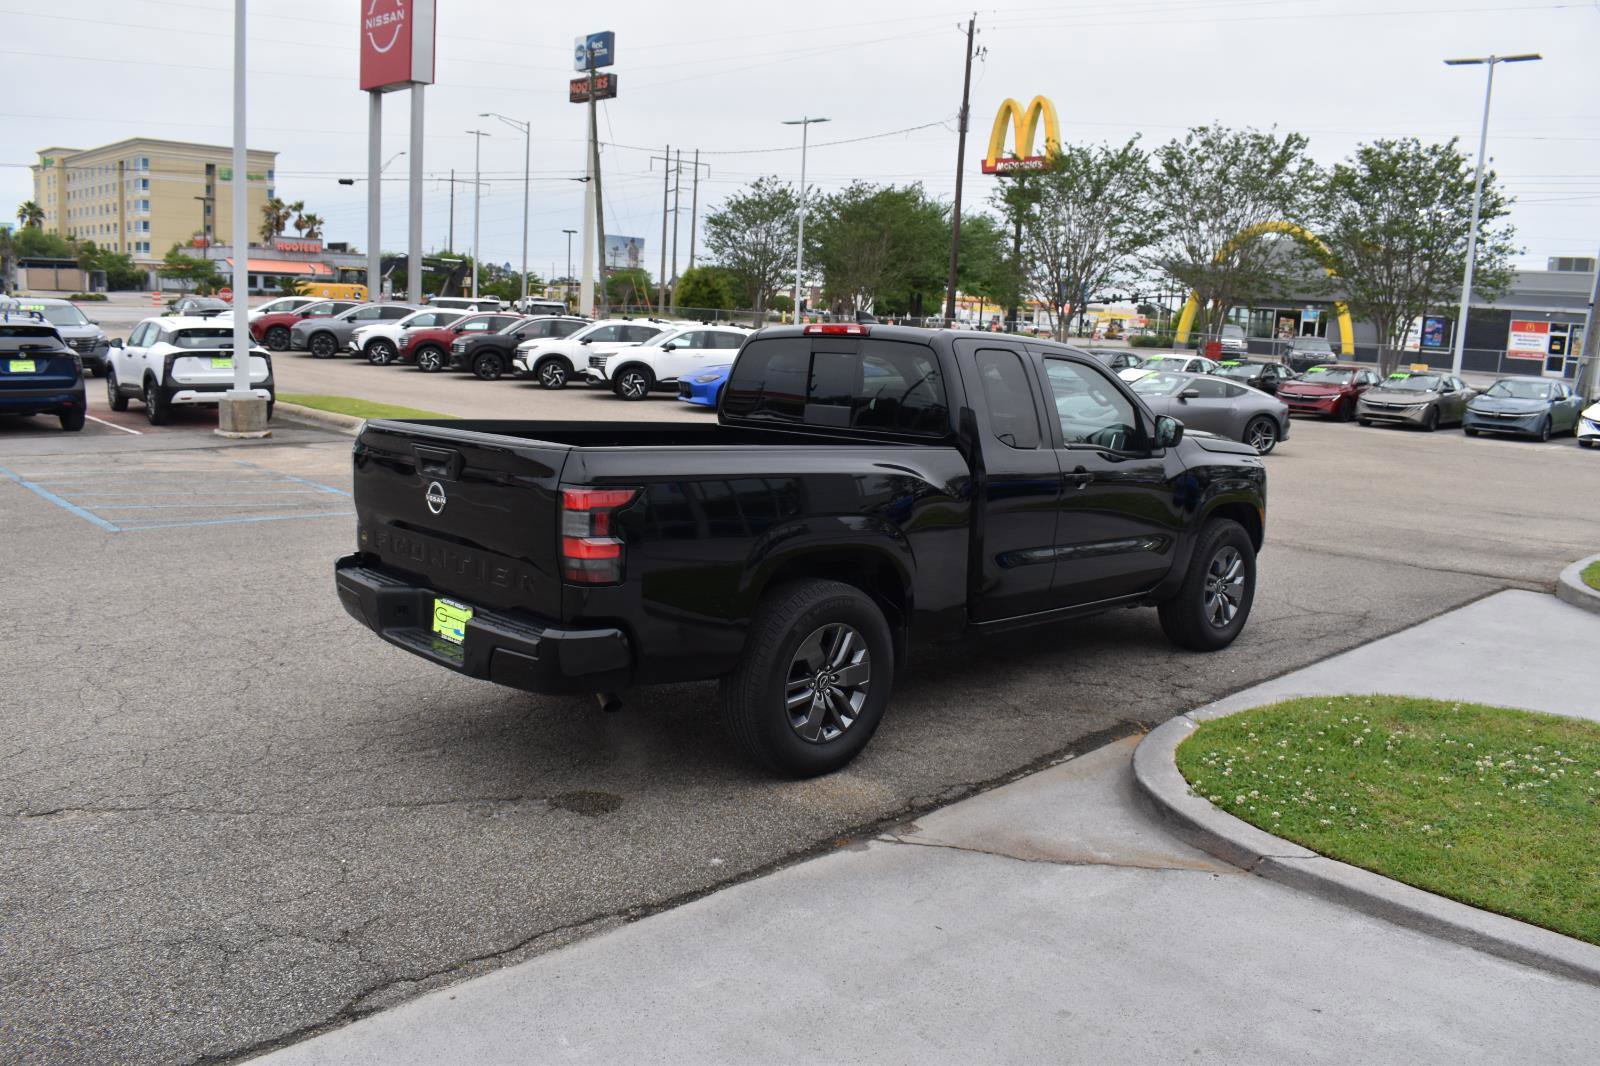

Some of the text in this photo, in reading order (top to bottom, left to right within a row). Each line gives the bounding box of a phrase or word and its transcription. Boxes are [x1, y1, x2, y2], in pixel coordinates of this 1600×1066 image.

[366, 8, 405, 31] NISSAN
[276, 242, 322, 254] HOOTERS
[374, 529, 536, 593] FRONTIER
